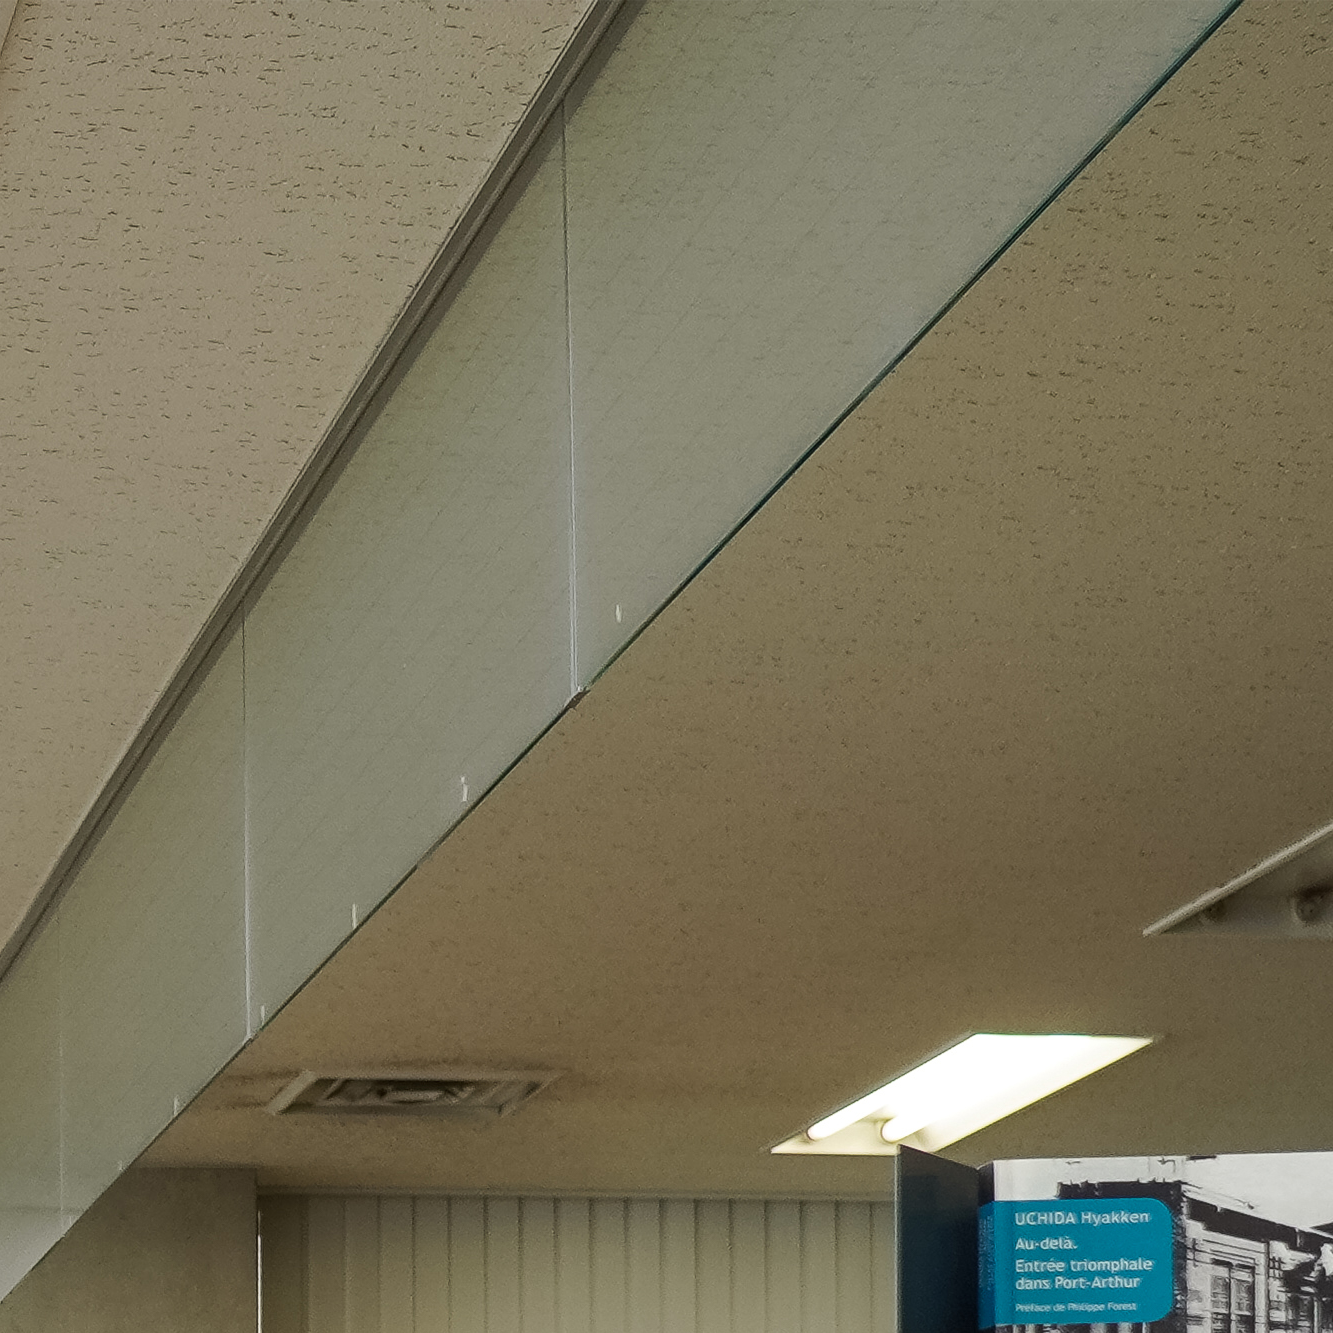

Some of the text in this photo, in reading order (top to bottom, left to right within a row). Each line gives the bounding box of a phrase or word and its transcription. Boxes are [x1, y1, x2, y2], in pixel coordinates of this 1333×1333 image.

[1014, 1210, 1151, 1227] UCHIDA Hyakken
[1015, 1257, 1154, 1273] Entrée triomphale
[1015, 1275, 1141, 1290] dans Port-Arthur
[1053, 1303, 1066, 1312] de
[1107, 1301, 1137, 1311] Forest
